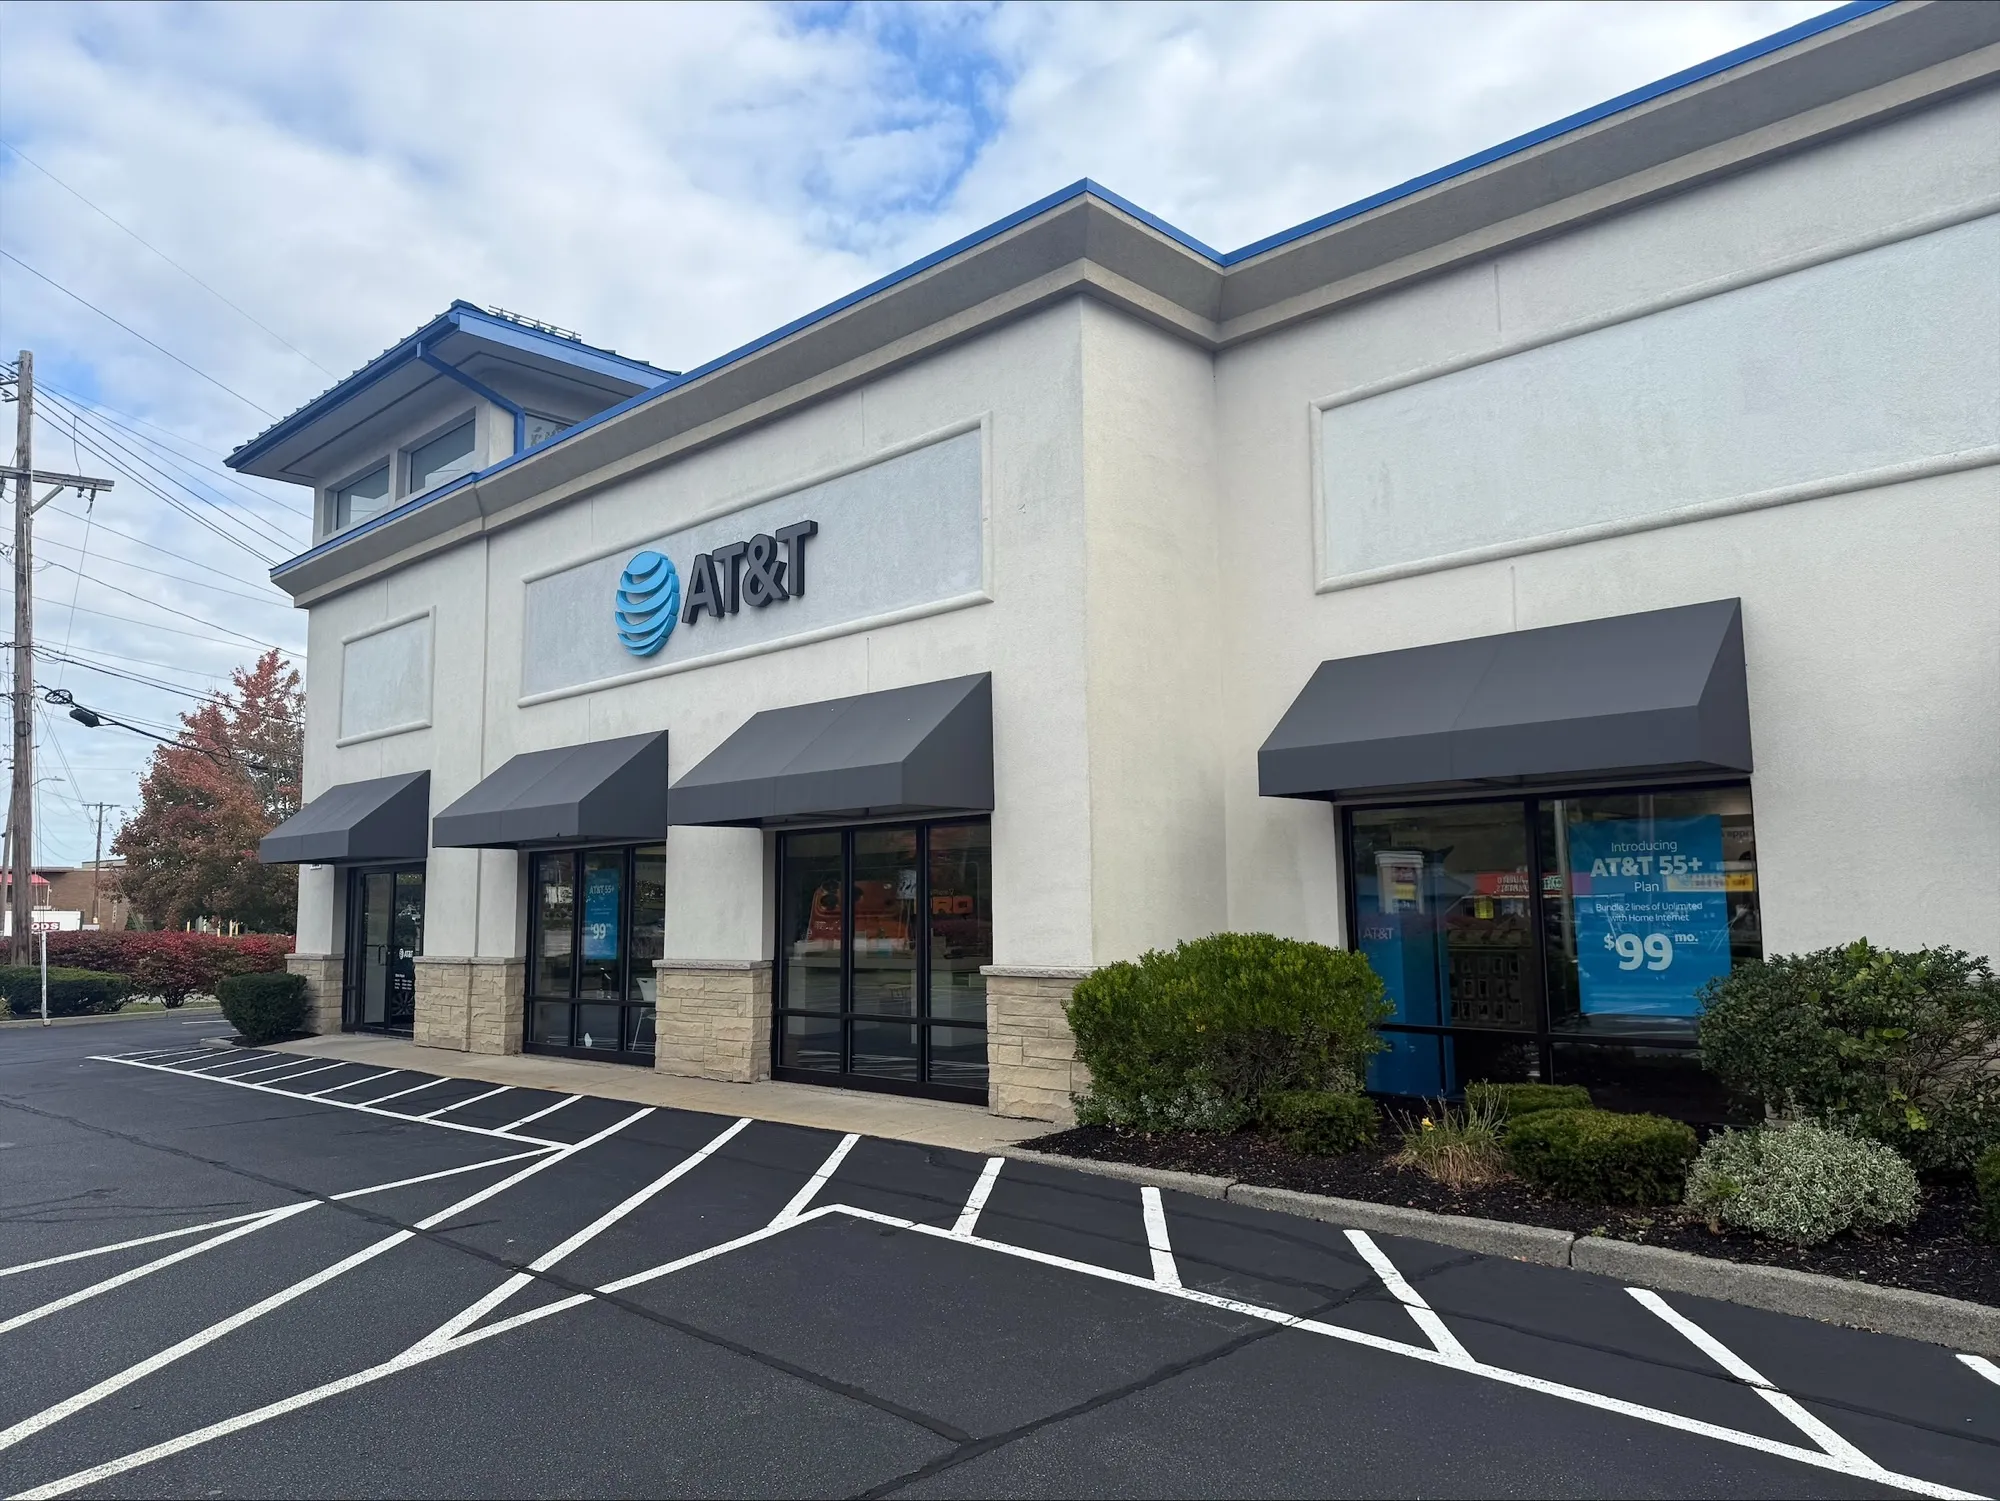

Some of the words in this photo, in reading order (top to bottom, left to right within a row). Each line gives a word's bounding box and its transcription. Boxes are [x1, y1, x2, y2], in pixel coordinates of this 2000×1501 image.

[682, 520, 818, 624] AT&T
[1611, 840, 1677, 852] Introducing
[1590, 856, 1653, 877] AT&T
[1659, 855, 1702, 875] 55+
[1634, 882, 1659, 892] Plan
[1595, 903, 1624, 912] Bundle
[1625, 903, 1630, 911] 2
[1631, 902, 1650, 911] lines
[1651, 902, 1661, 911] of
[1662, 902, 1703, 911] Unlimited
[1611, 914, 1628, 922] with
[1628, 914, 1654, 922] Home
[1655, 913, 1690, 922] Internet
[31, 922, 59, 930] ODS
[1363, 927, 1394, 940] AT&T
[1674, 933, 1699, 942] mo.
